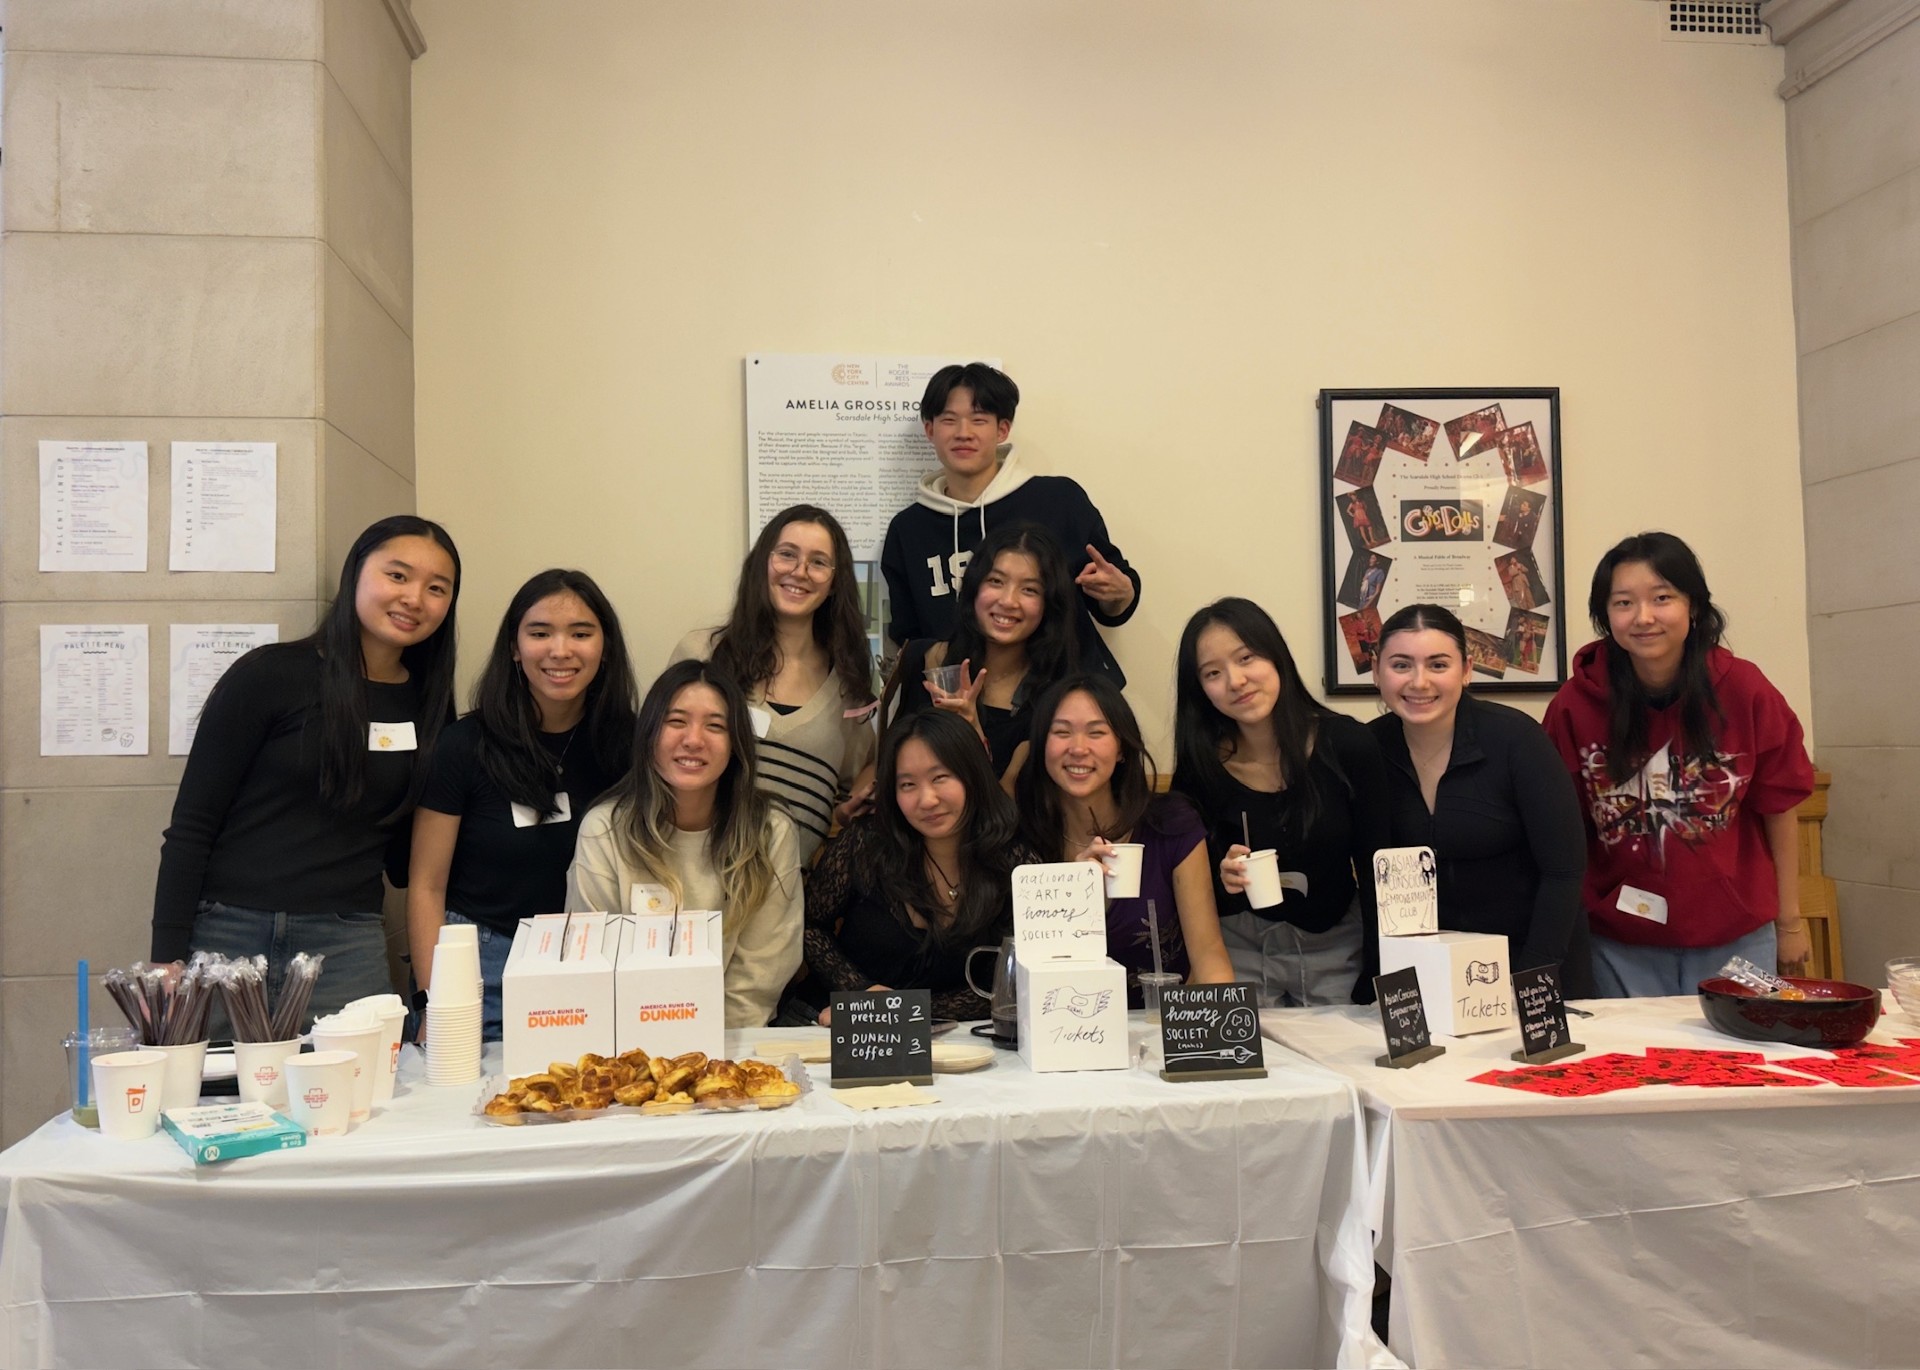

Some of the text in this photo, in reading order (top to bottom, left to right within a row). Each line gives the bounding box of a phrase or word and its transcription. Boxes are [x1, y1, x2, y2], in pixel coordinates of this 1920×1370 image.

[786, 400, 840, 410] AMELIA
[844, 400, 896, 411] GROSSI
[836, 413, 919, 424] Scarsdale High School
[105, 642, 125, 650] MENU
[1019, 872, 1081, 884] national
[1035, 889, 1059, 900] ART
[1023, 906, 1089, 922] honors
[1400, 906, 1418, 918] CLUB
[1022, 930, 1064, 941] SOCIETY
[1164, 987, 1247, 1004] national ART
[1384, 992, 1399, 1006] Asian
[850, 998, 922, 1016] mini 2
[1457, 995, 1507, 1018] Tickets
[528, 1014, 588, 1028] DUNKIN'
[640, 1008, 698, 1022] DUNKIN'
[851, 1012, 899, 1025] pretzels
[1166, 1006, 1222, 1027] honors
[1050, 1025, 1104, 1044] Tickets
[1166, 1027, 1209, 1040] SOCIETY
[852, 1032, 921, 1051] DUNKIN 3
[852, 1045, 893, 1060] coffee
[132, 1098, 140, 1106] D
[206, 1148, 218, 1158] M
